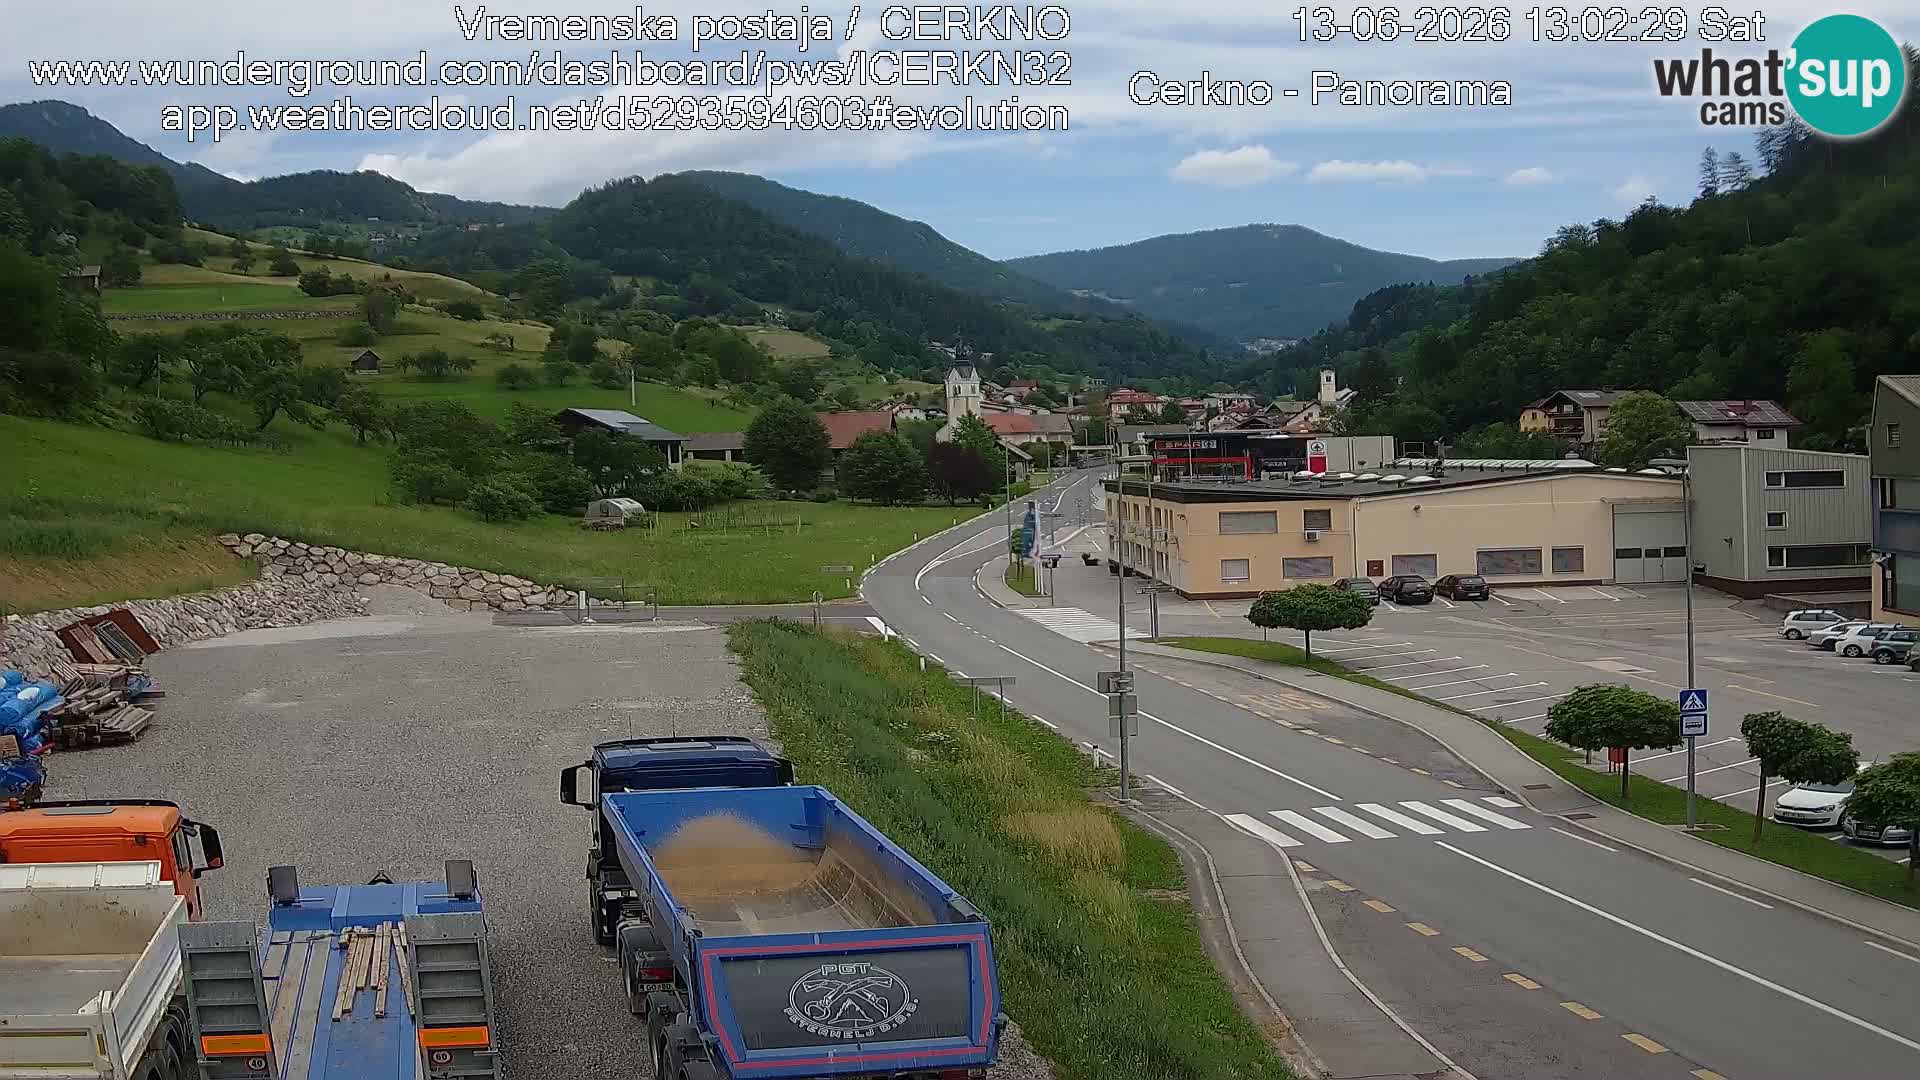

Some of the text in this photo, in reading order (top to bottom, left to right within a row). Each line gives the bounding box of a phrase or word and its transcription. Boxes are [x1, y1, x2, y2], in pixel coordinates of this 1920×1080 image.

[1165, 441, 1201, 449] SPAR
[821, 962, 871, 976] PGT
[783, 1006, 875, 1039] PETERNELJ
[435, 1052, 448, 1060] 60
